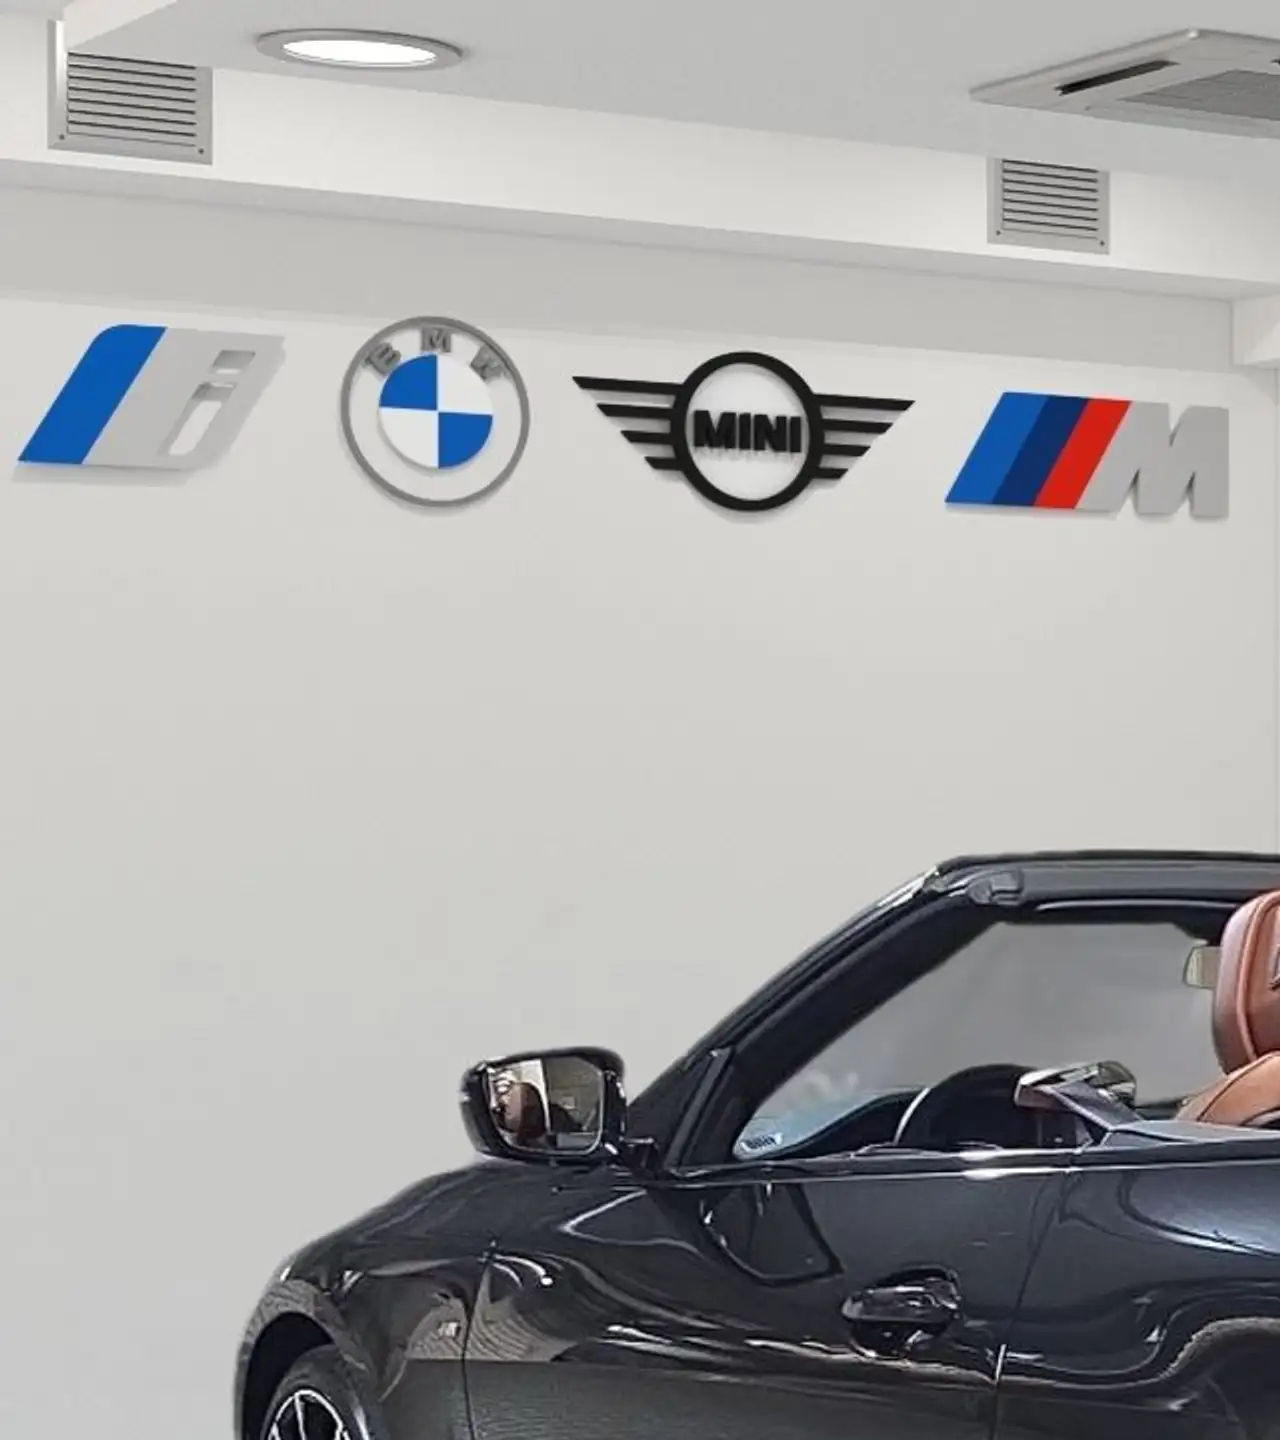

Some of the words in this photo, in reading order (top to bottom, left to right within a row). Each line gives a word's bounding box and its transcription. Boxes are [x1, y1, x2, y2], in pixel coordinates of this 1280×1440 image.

[363, 327, 502, 379] BMW
[693, 409, 802, 453] MINI
[1075, 401, 1230, 518] M
